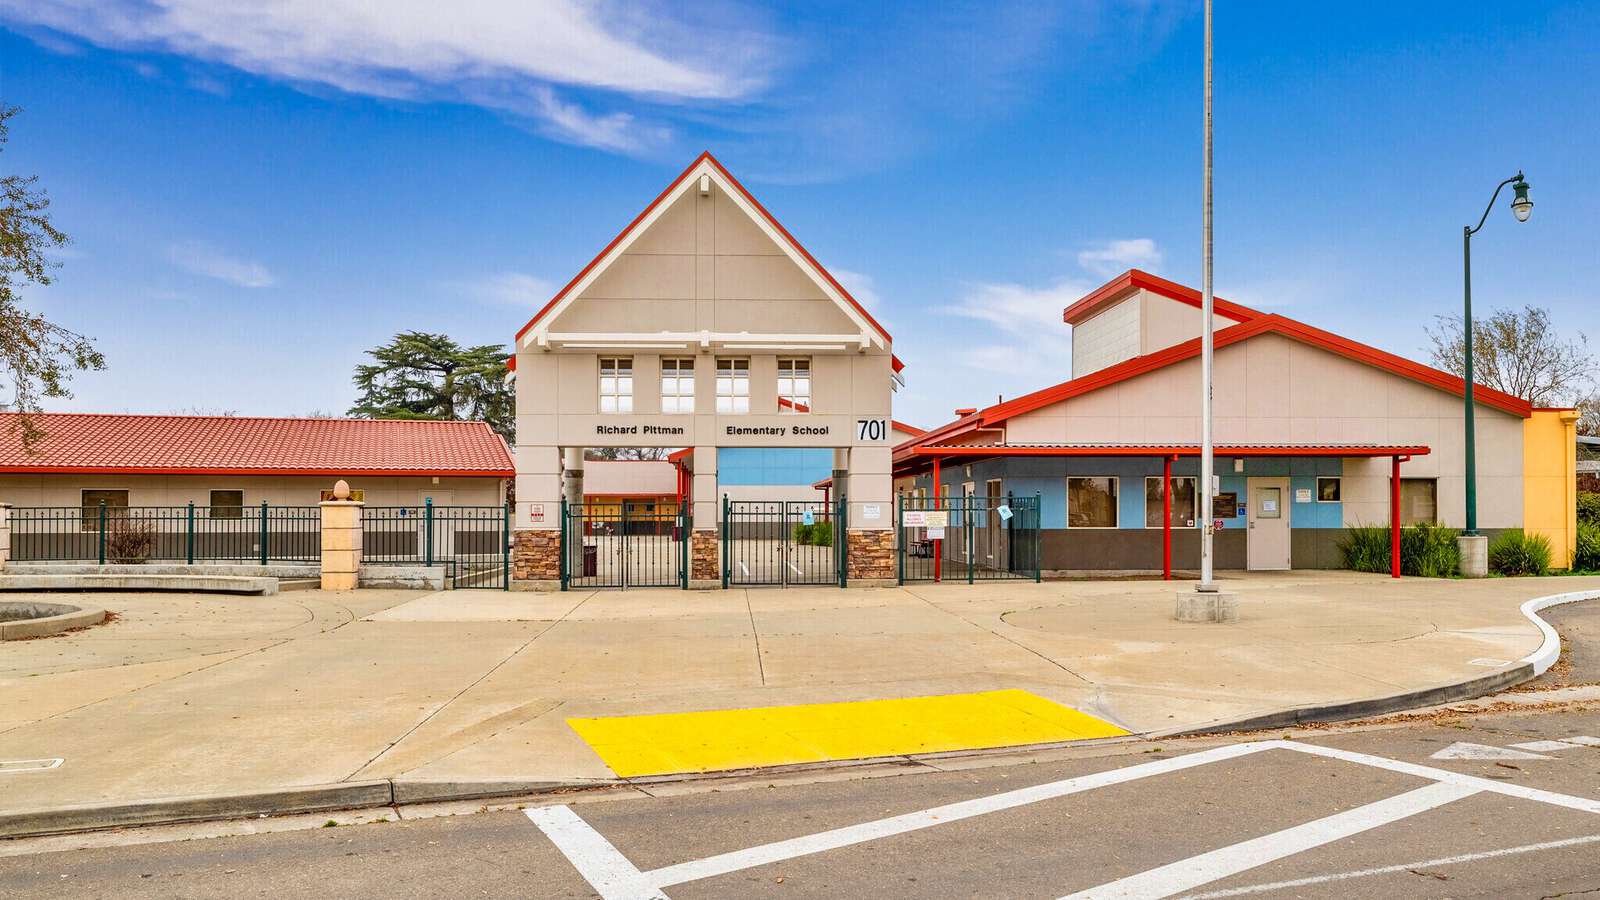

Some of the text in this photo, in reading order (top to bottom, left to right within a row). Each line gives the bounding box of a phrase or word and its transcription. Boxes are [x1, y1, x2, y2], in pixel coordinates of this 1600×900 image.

[596, 425, 684, 435] Richard Pittman
[726, 425, 829, 437] Elementary School
[857, 419, 886, 441] 701
